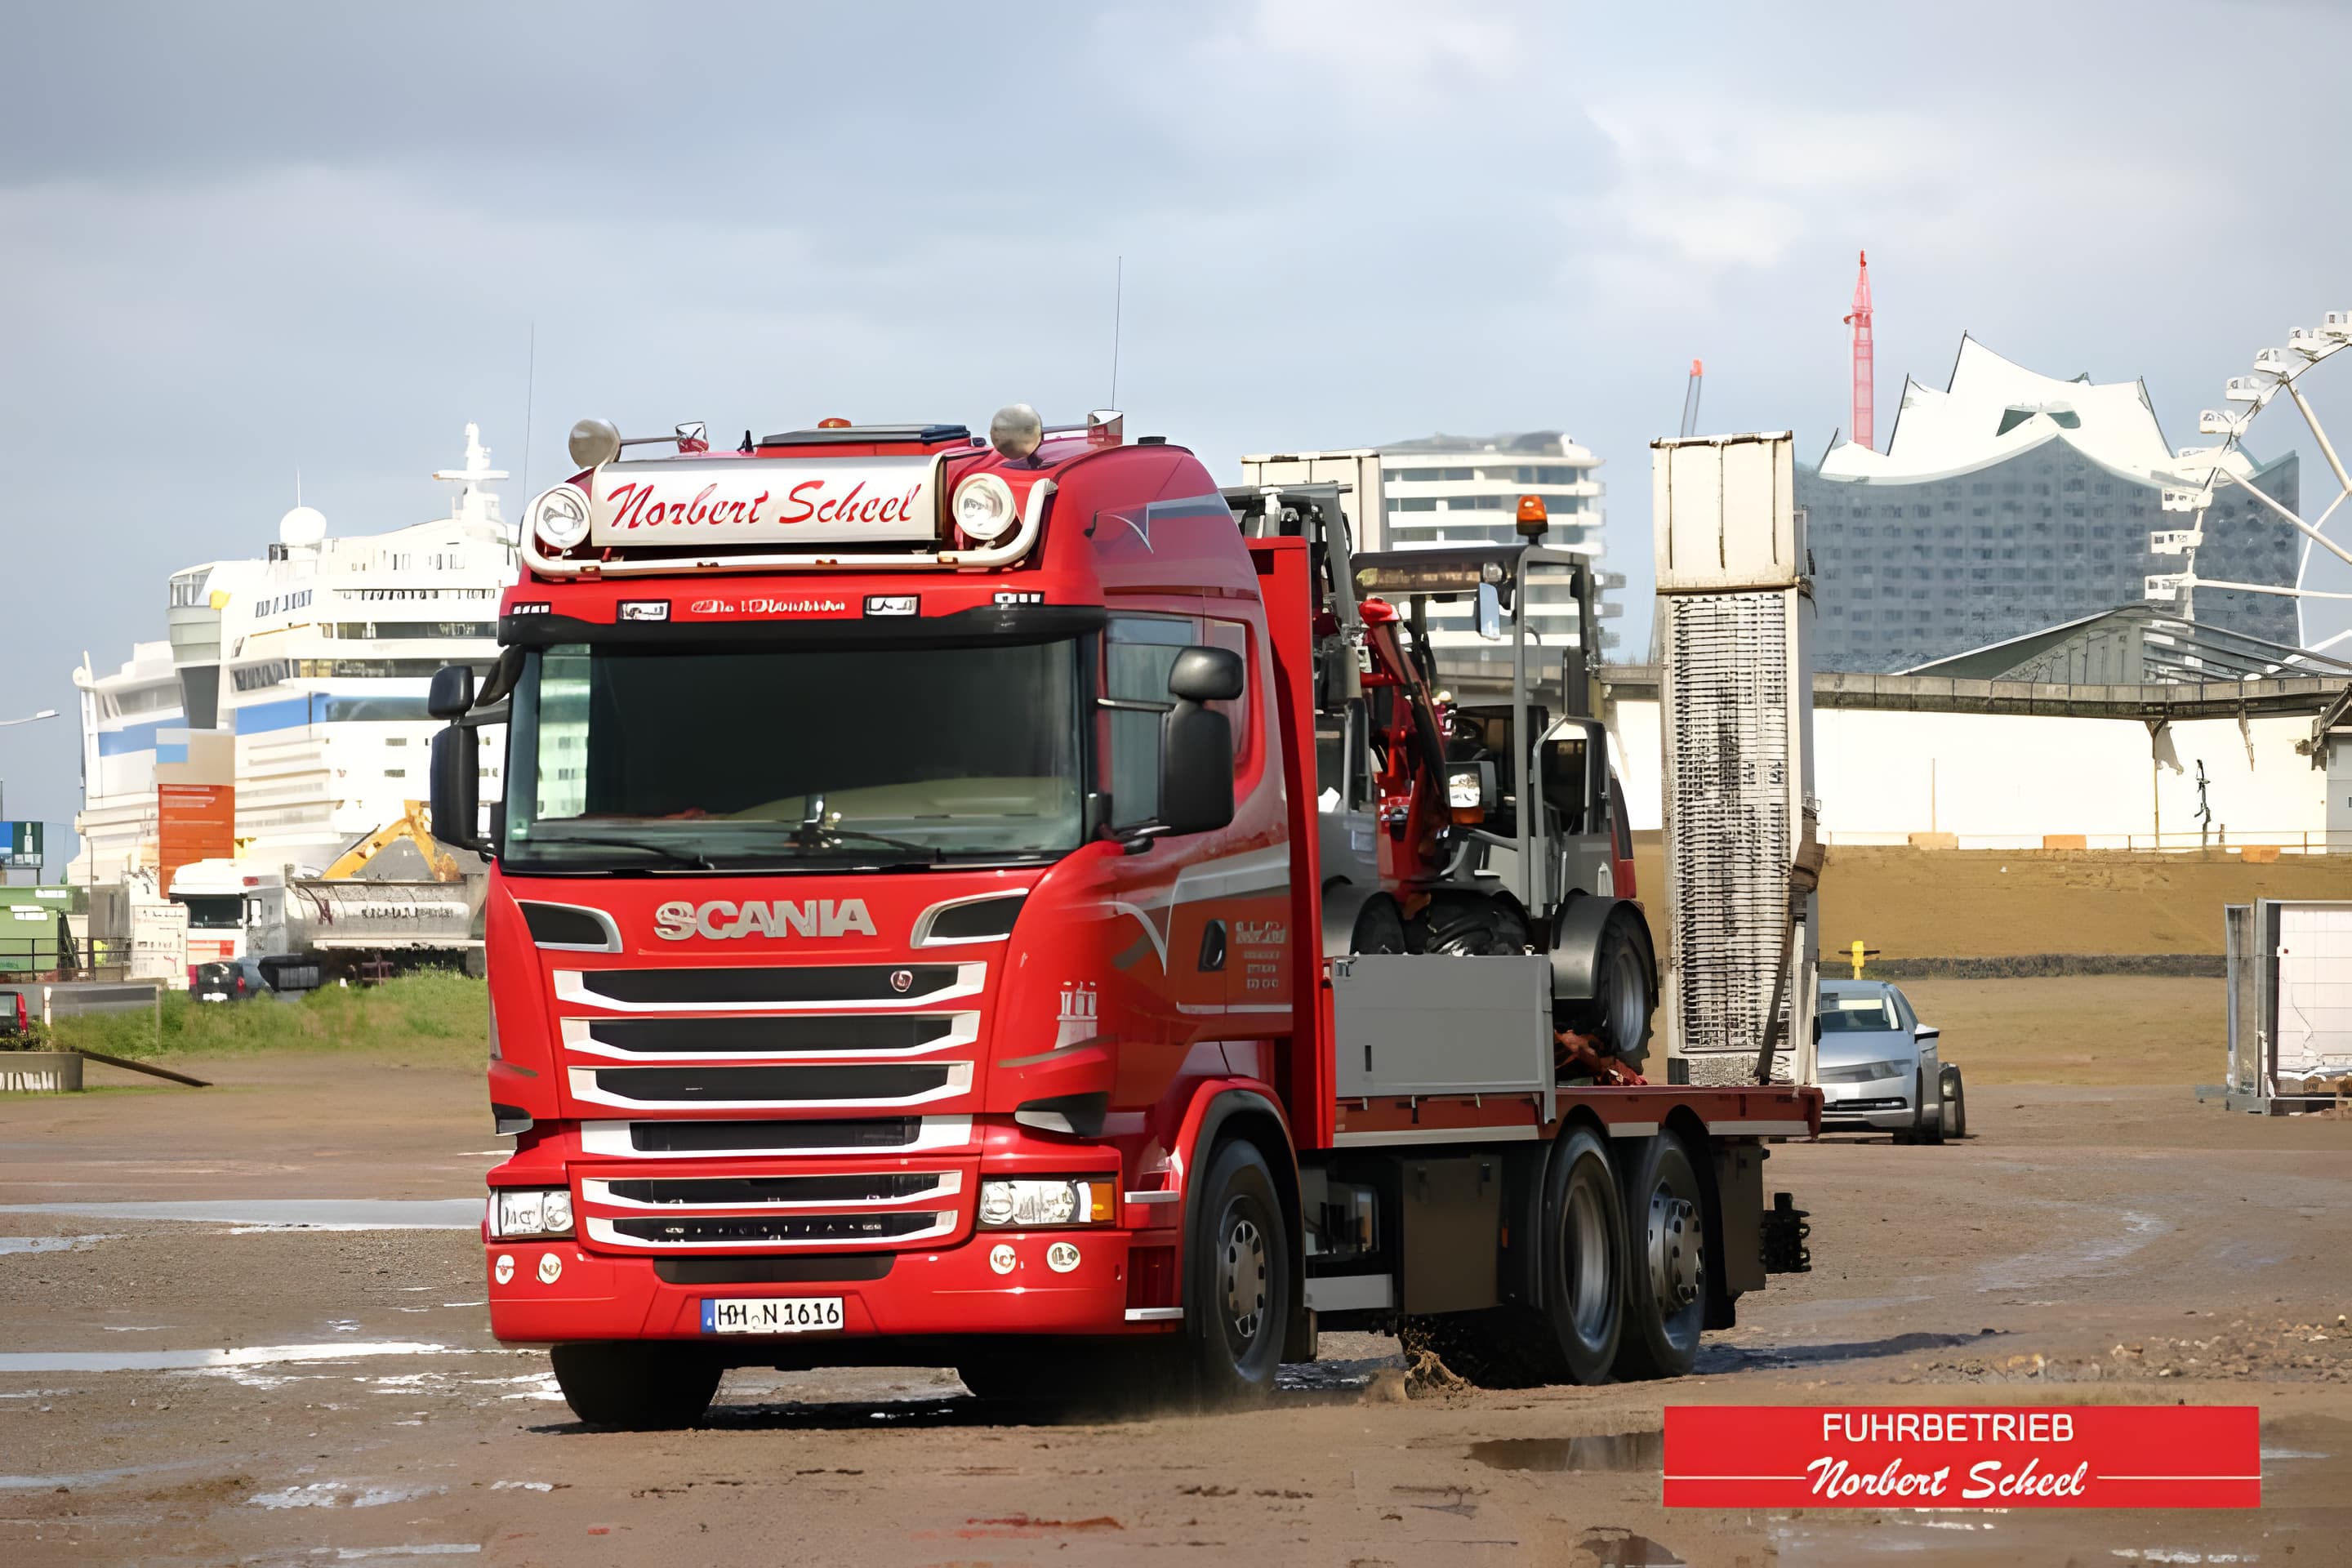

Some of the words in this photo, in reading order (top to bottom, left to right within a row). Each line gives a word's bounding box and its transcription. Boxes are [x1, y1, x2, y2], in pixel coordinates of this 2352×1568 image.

[607, 483, 770, 529] Norbert
[778, 480, 922, 524] Scheel
[654, 898, 877, 940] SCANIA
[718, 1304, 747, 1325] HH
